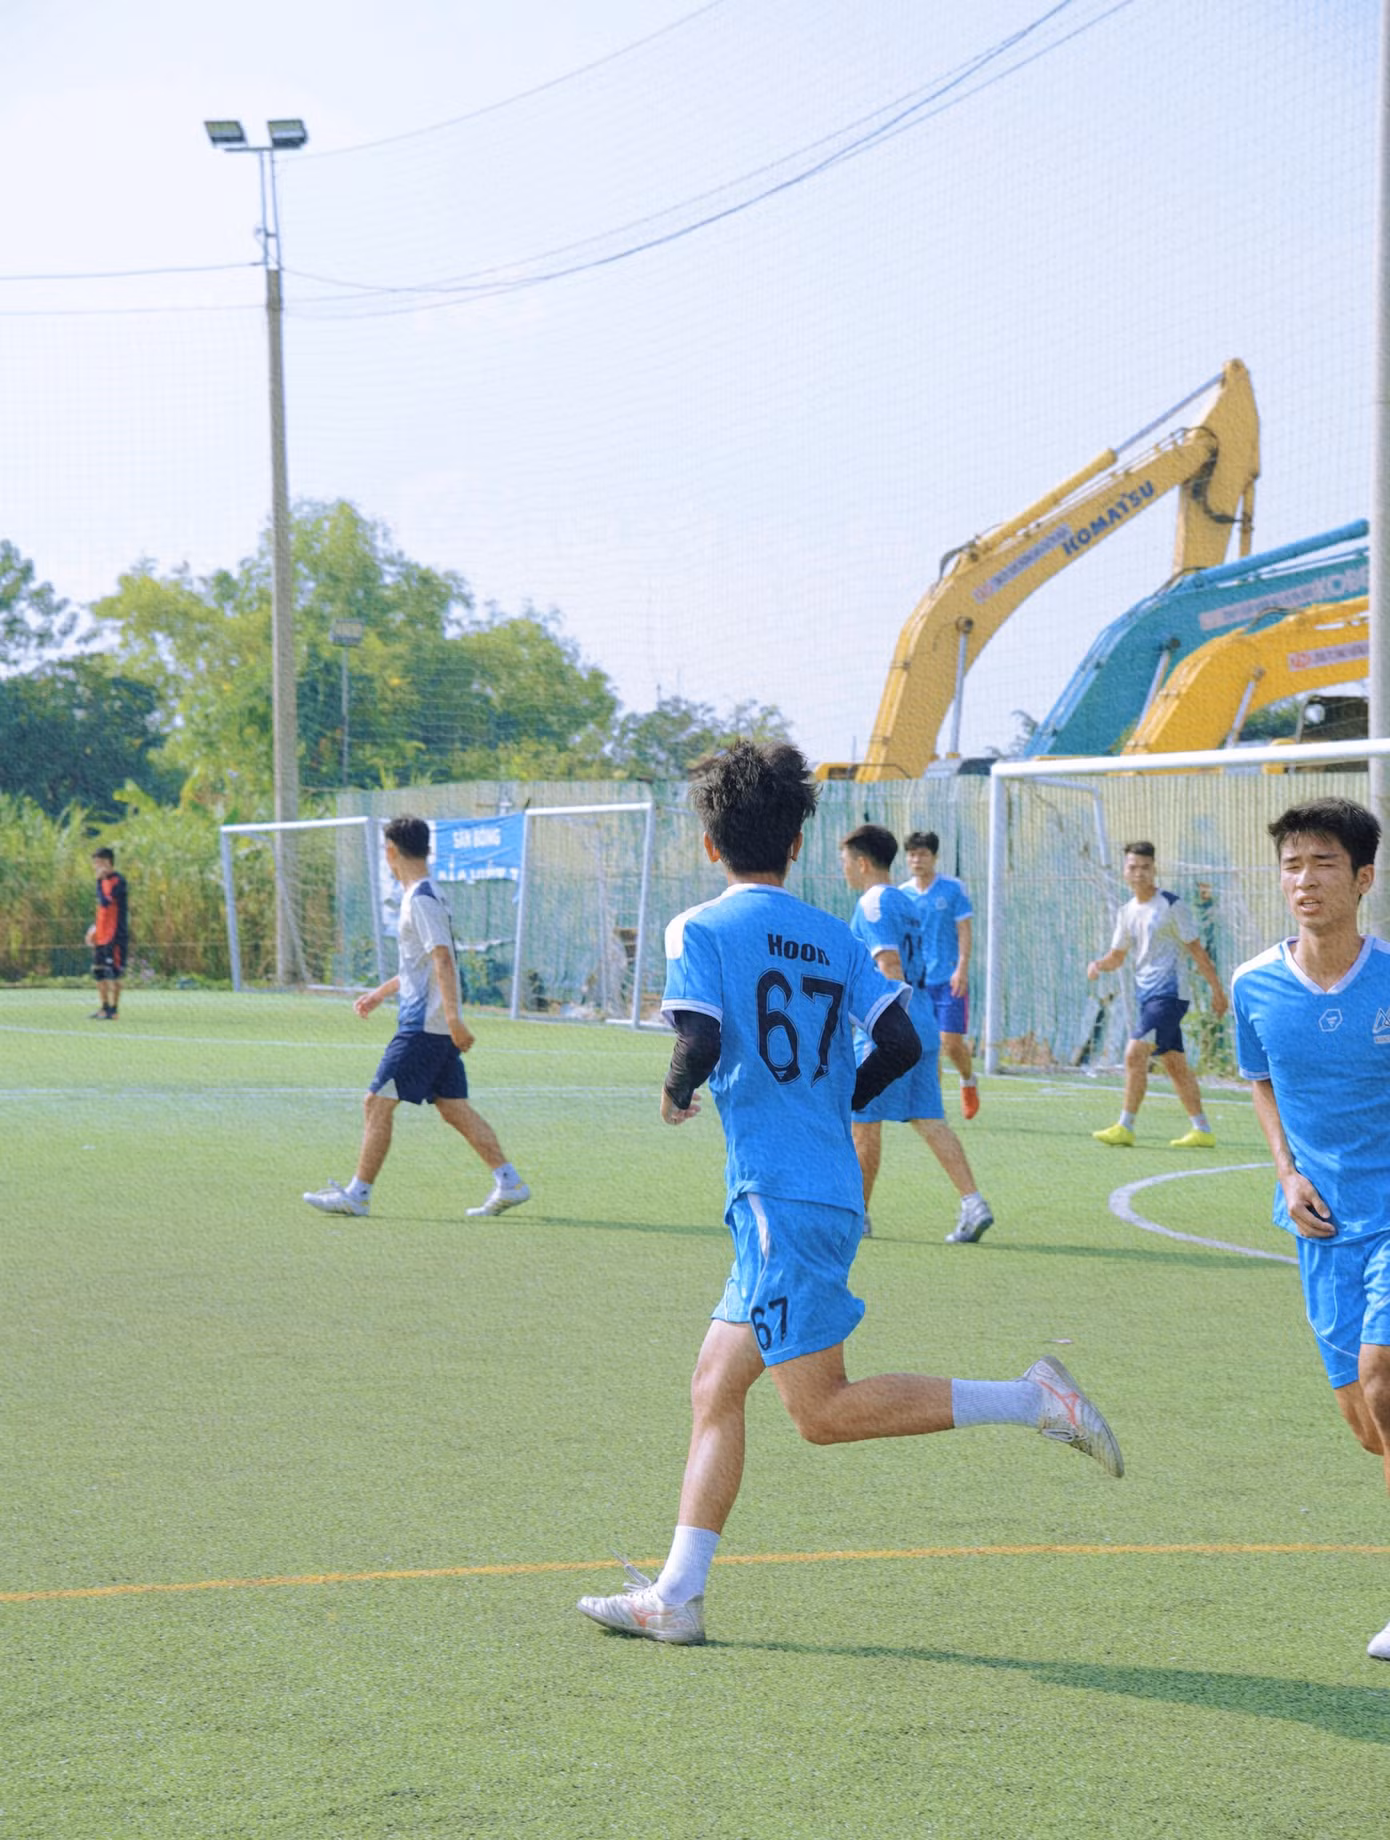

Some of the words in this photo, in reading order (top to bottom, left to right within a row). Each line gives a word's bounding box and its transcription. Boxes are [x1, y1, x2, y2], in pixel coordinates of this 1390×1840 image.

[1061, 481, 1155, 556] KOMATSU
[756, 967, 846, 1088] 67
[750, 1296, 789, 1351] 67
